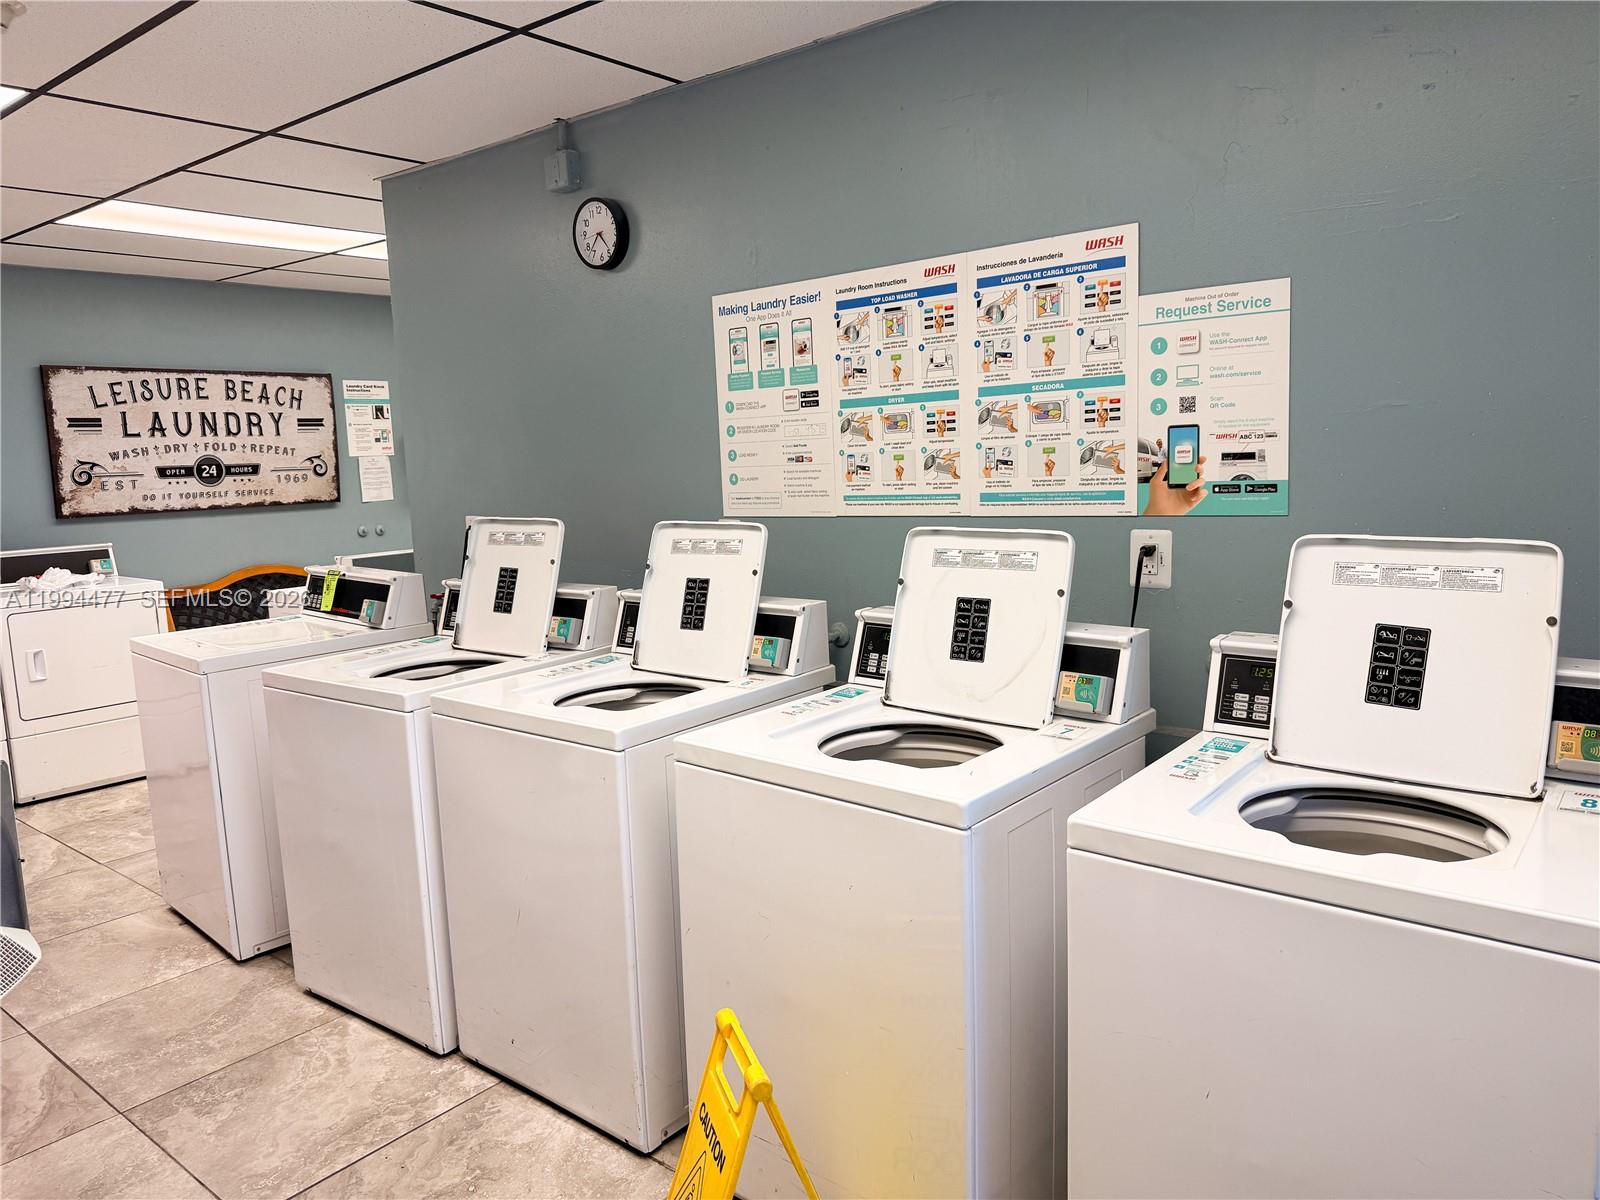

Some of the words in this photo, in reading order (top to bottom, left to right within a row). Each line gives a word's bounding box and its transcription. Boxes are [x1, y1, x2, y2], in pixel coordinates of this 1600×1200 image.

[589, 209, 594, 218] 11
[596, 206, 602, 214] 12
[605, 208, 608, 216] 1
[584, 219, 589, 228] 10
[583, 231, 587, 239] 9
[586, 242, 590, 251] 8
[1085, 235, 1124, 251] WASH
[592, 250, 596, 258] 7
[600, 253, 604, 261] 6
[607, 249, 611, 258] 5
[977, 260, 1018, 271] Instrucciones
[1028, 252, 1063, 263] Lavandería
[924, 264, 955, 278] WASH
[1001, 273, 1031, 283] LAVADORA
[1042, 269, 1064, 278] CARGA
[1065, 264, 1098, 274] SUPERIOR
[836, 285, 856, 294] Laundry
[857, 283, 873, 291] Room
[874, 278, 907, 288] Instructions
[896, 292, 918, 301] WASHER
[718, 304, 748, 316] Making
[751, 298, 787, 312] Laundry
[790, 291, 821, 306] Easier!
[1156, 302, 1212, 320] Request
[1216, 296, 1272, 312] Service
[757, 313, 767, 322] App
[1209, 337, 1254, 345] WASH-Connect
[1209, 370, 1261, 379] wash.com/service
[88, 377, 209, 409] LEISURE
[224, 379, 303, 410] BEACH
[119, 411, 283, 438] LAUNDRY
[108, 446, 149, 462] WASH
[164, 442, 188, 454] DRY
[204, 442, 236, 452] FOLD
[250, 444, 296, 456] REPEAT
[202, 466, 217, 477] 24
[276, 473, 308, 484] 1969
[100, 479, 139, 492] EST
[142, 494, 156, 502] DO
[178, 491, 229, 500] YOURSELF
[235, 488, 274, 497] SERVICE
[1581, 799, 1598, 808] 8
[699, 1102, 726, 1174] CAUTION
